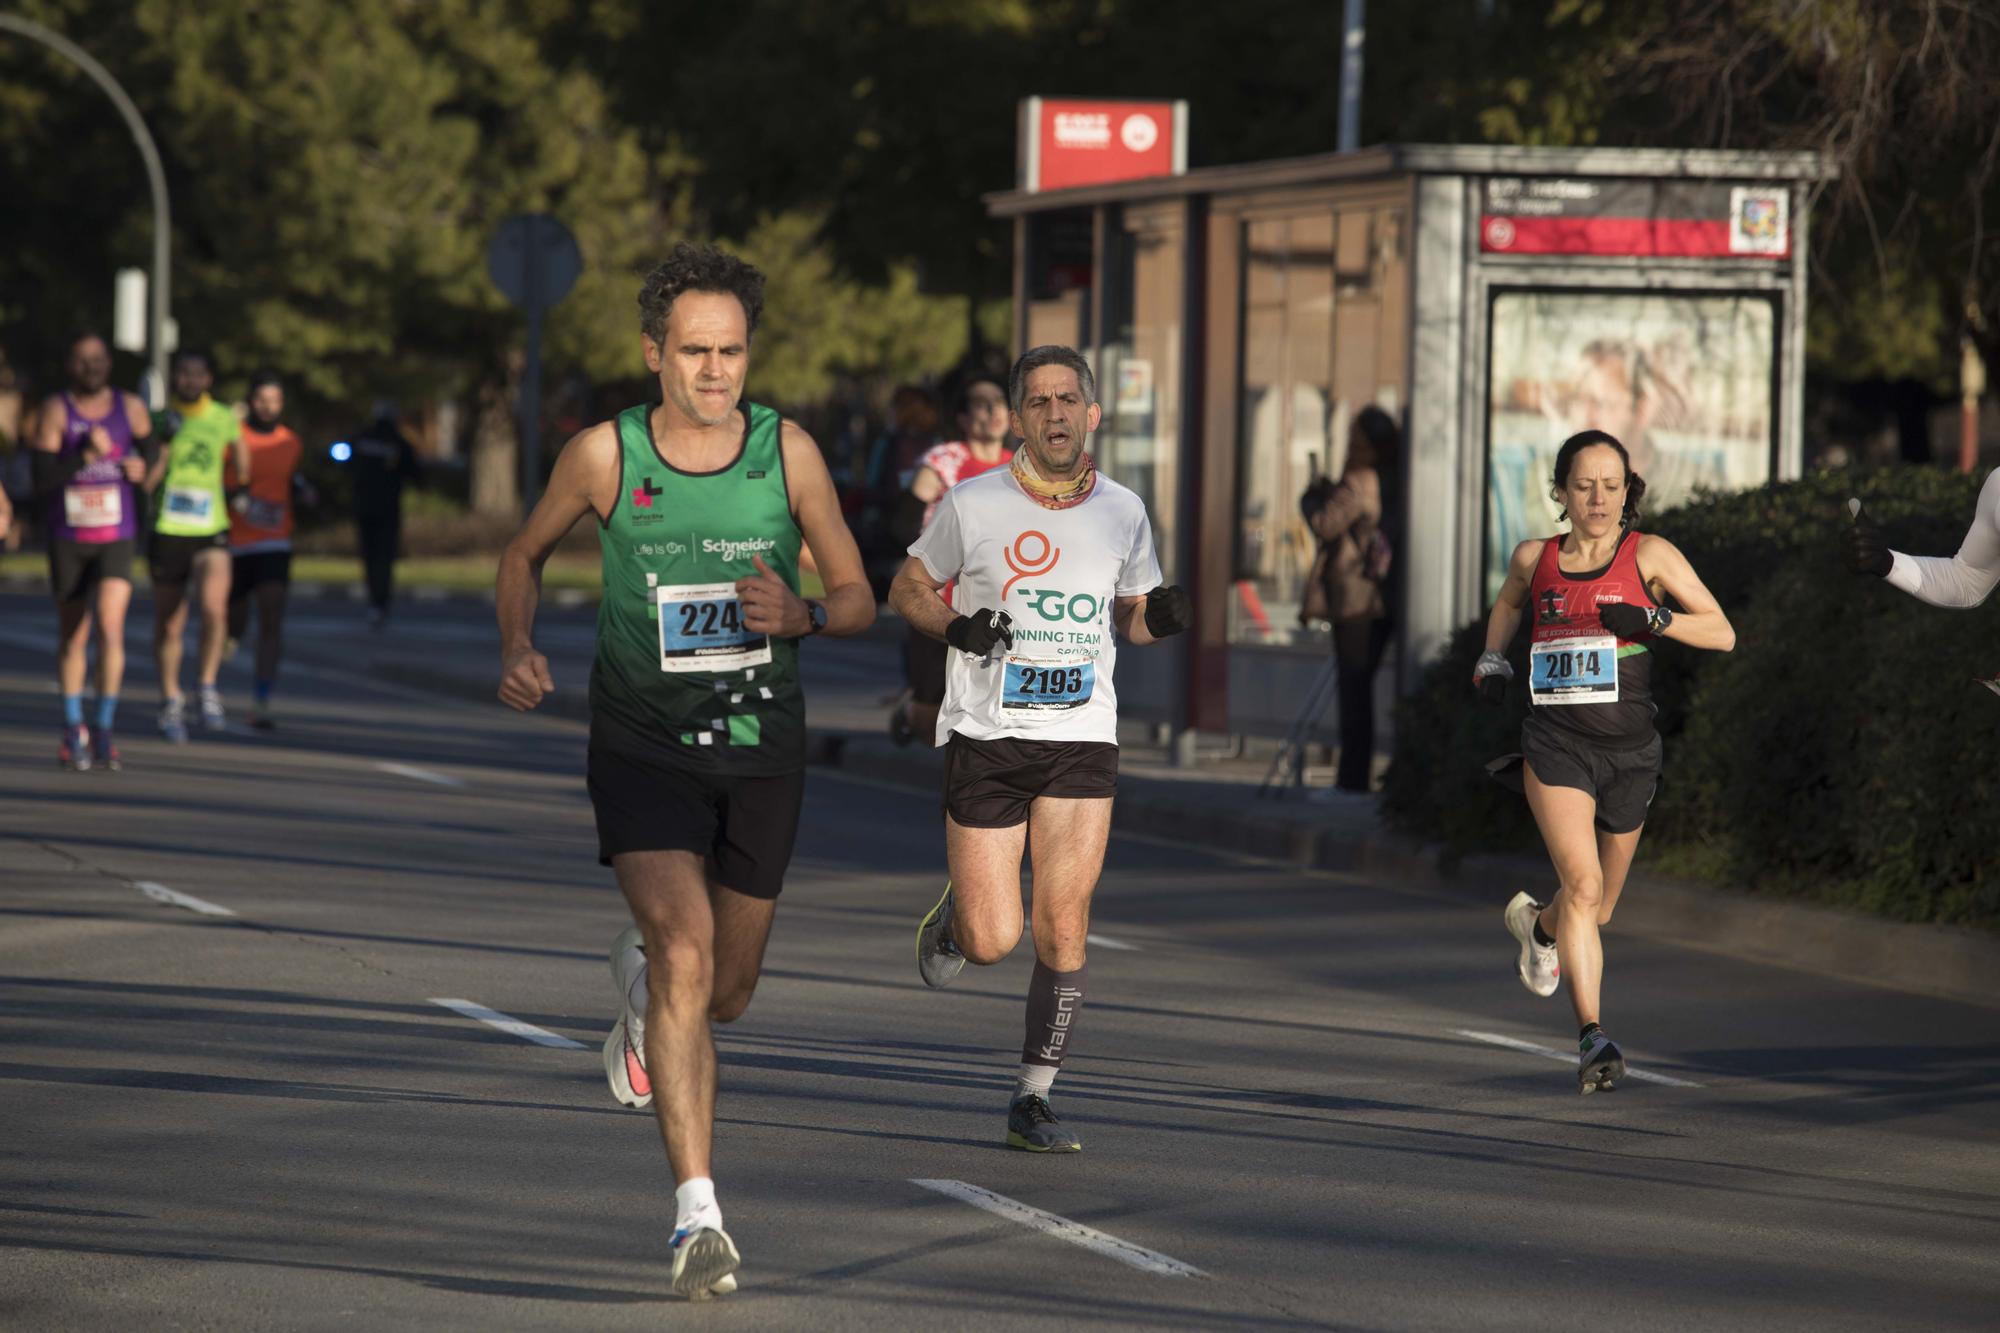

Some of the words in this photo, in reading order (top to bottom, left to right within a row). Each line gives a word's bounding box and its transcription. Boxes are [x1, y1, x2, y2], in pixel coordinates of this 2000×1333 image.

[633, 543, 653, 556] Life
[655, 543, 665, 555] Is
[666, 541, 687, 555] On
[702, 537, 776, 553] Schneider
[680, 602, 750, 637] 224
[1026, 589, 1105, 625] GO!
[1068, 632, 1101, 645] TEAM
[1546, 651, 1600, 678] 2014
[1020, 668, 1082, 694] 2193
[1041, 986, 1081, 1060] kalenji
